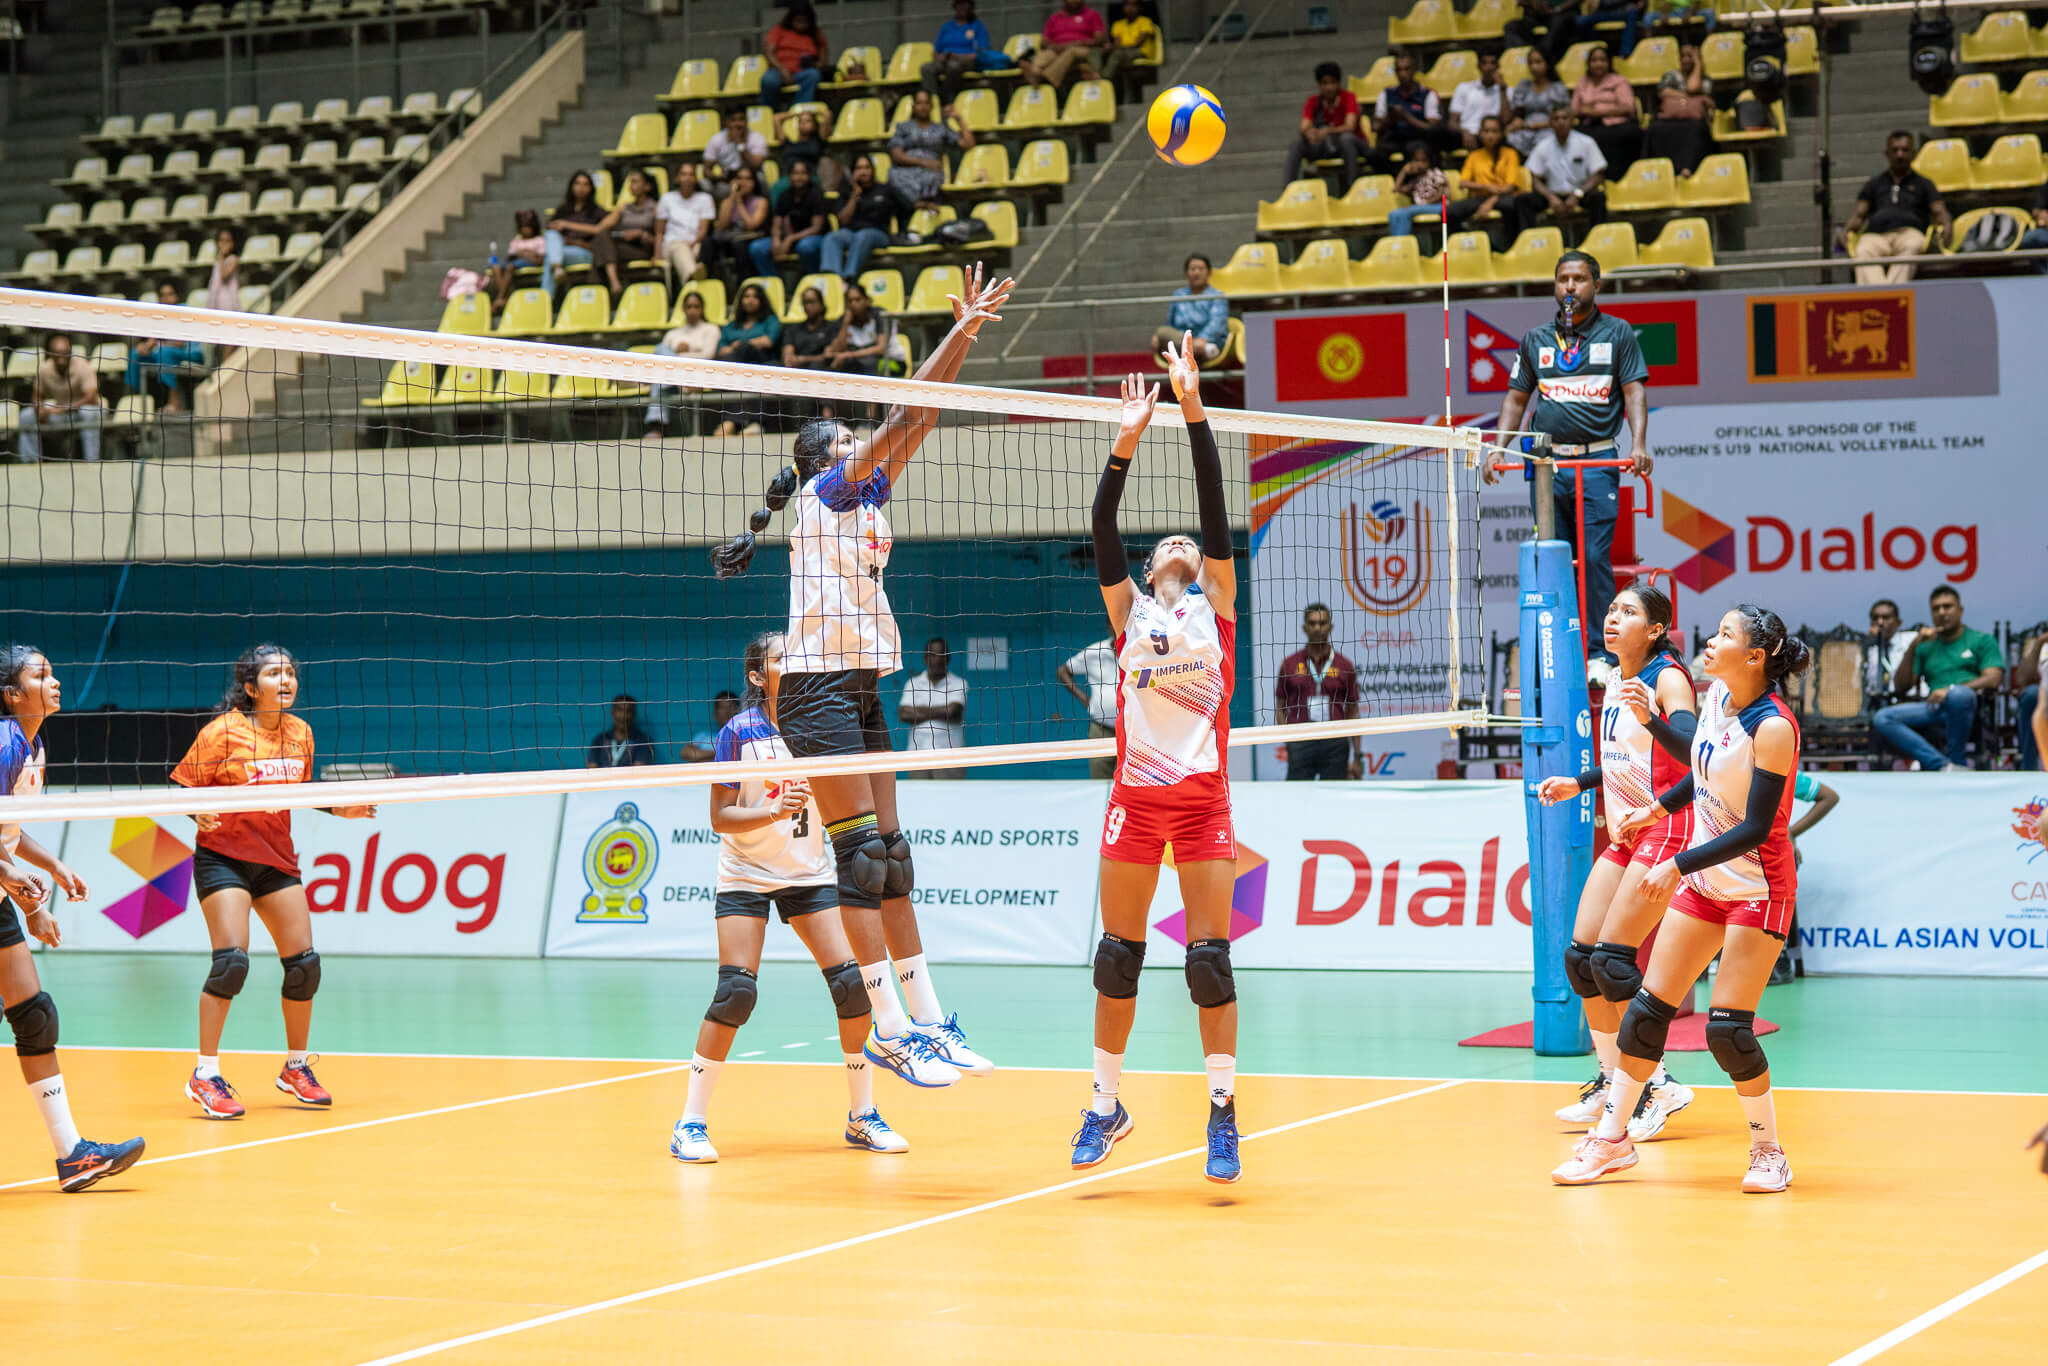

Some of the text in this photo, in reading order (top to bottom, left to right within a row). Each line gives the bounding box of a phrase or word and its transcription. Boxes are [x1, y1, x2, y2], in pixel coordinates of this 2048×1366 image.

[1554, 385, 1610, 400] Dialog
[1715, 421, 1917, 439] OFFICIAL SPONSOR OF THE
[1653, 436, 1985, 457] WOMEN'S U19 NATIONAL VOLLEYBALL TEAM
[1745, 511, 1978, 583] Dialog
[1365, 555, 1407, 589] 19
[1156, 660, 1205, 677] IMPERIAL
[1603, 706, 1621, 741] 12
[1364, 752, 1406, 775] VC
[792, 808, 809, 838] 3
[1105, 806, 1127, 845] 9
[671, 829, 1079, 846] MINIS AIRS AND SPORTS
[304, 831, 506, 934] alog
[2011, 881, 2048, 901] CA
[663, 886, 1060, 906] DEPA DEVELOPMENT
[1799, 927, 2048, 949] NTRAL ASIAN VOL
